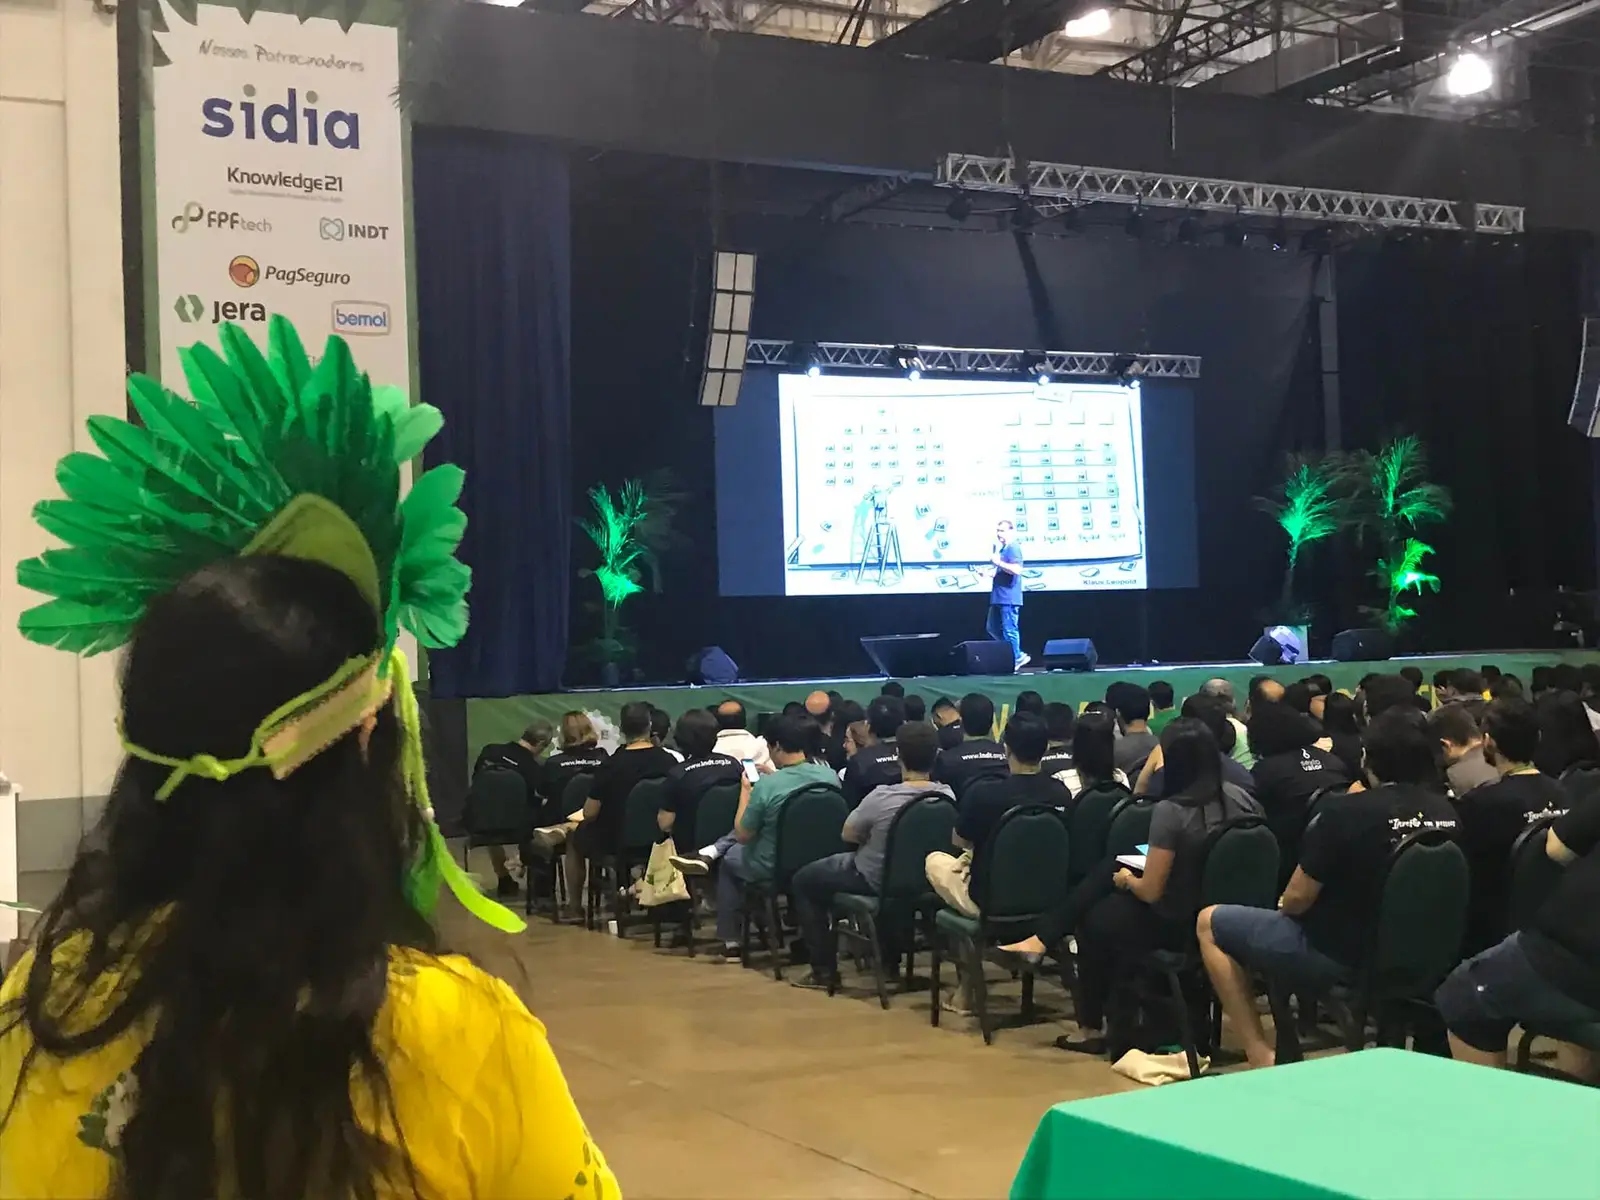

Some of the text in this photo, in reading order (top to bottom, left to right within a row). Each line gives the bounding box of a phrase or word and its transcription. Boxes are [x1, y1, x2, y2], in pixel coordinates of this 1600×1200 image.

[201, 84, 360, 150] sidia
[227, 166, 343, 192] Knowledge21
[348, 224, 389, 240] INDT
[265, 265, 351, 287] PagSeguro
[212, 301, 266, 323] jera
[336, 308, 387, 327] bemol
